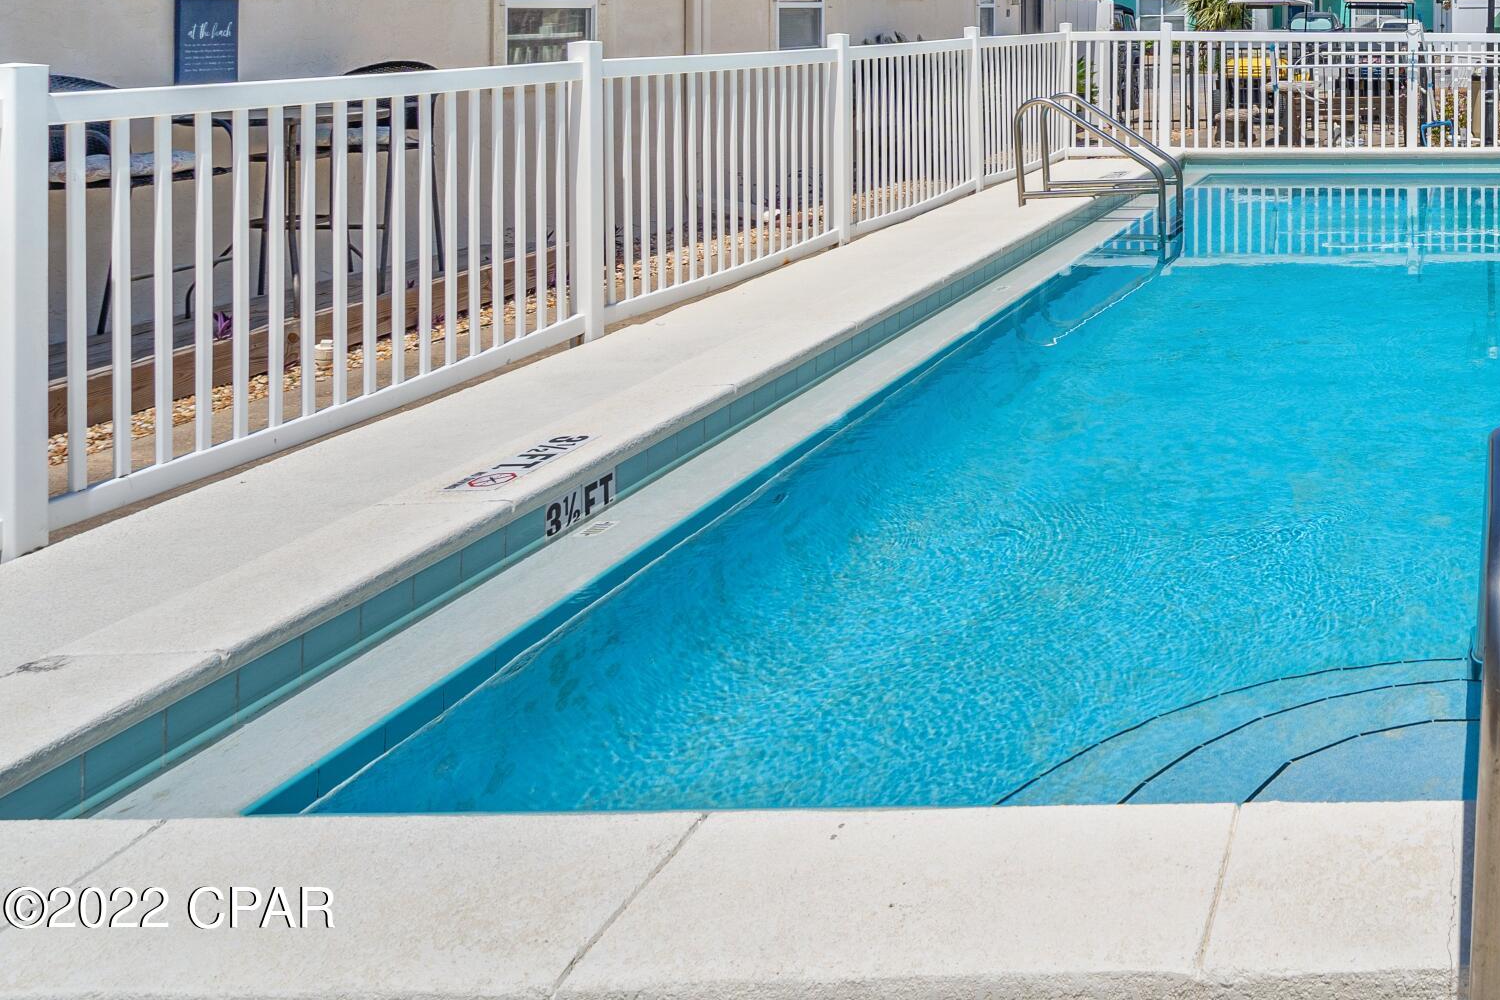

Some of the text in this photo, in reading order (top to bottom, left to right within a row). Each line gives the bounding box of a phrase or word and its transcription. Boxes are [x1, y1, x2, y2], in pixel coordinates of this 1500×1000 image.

[187, 21, 233, 40] at the beach
